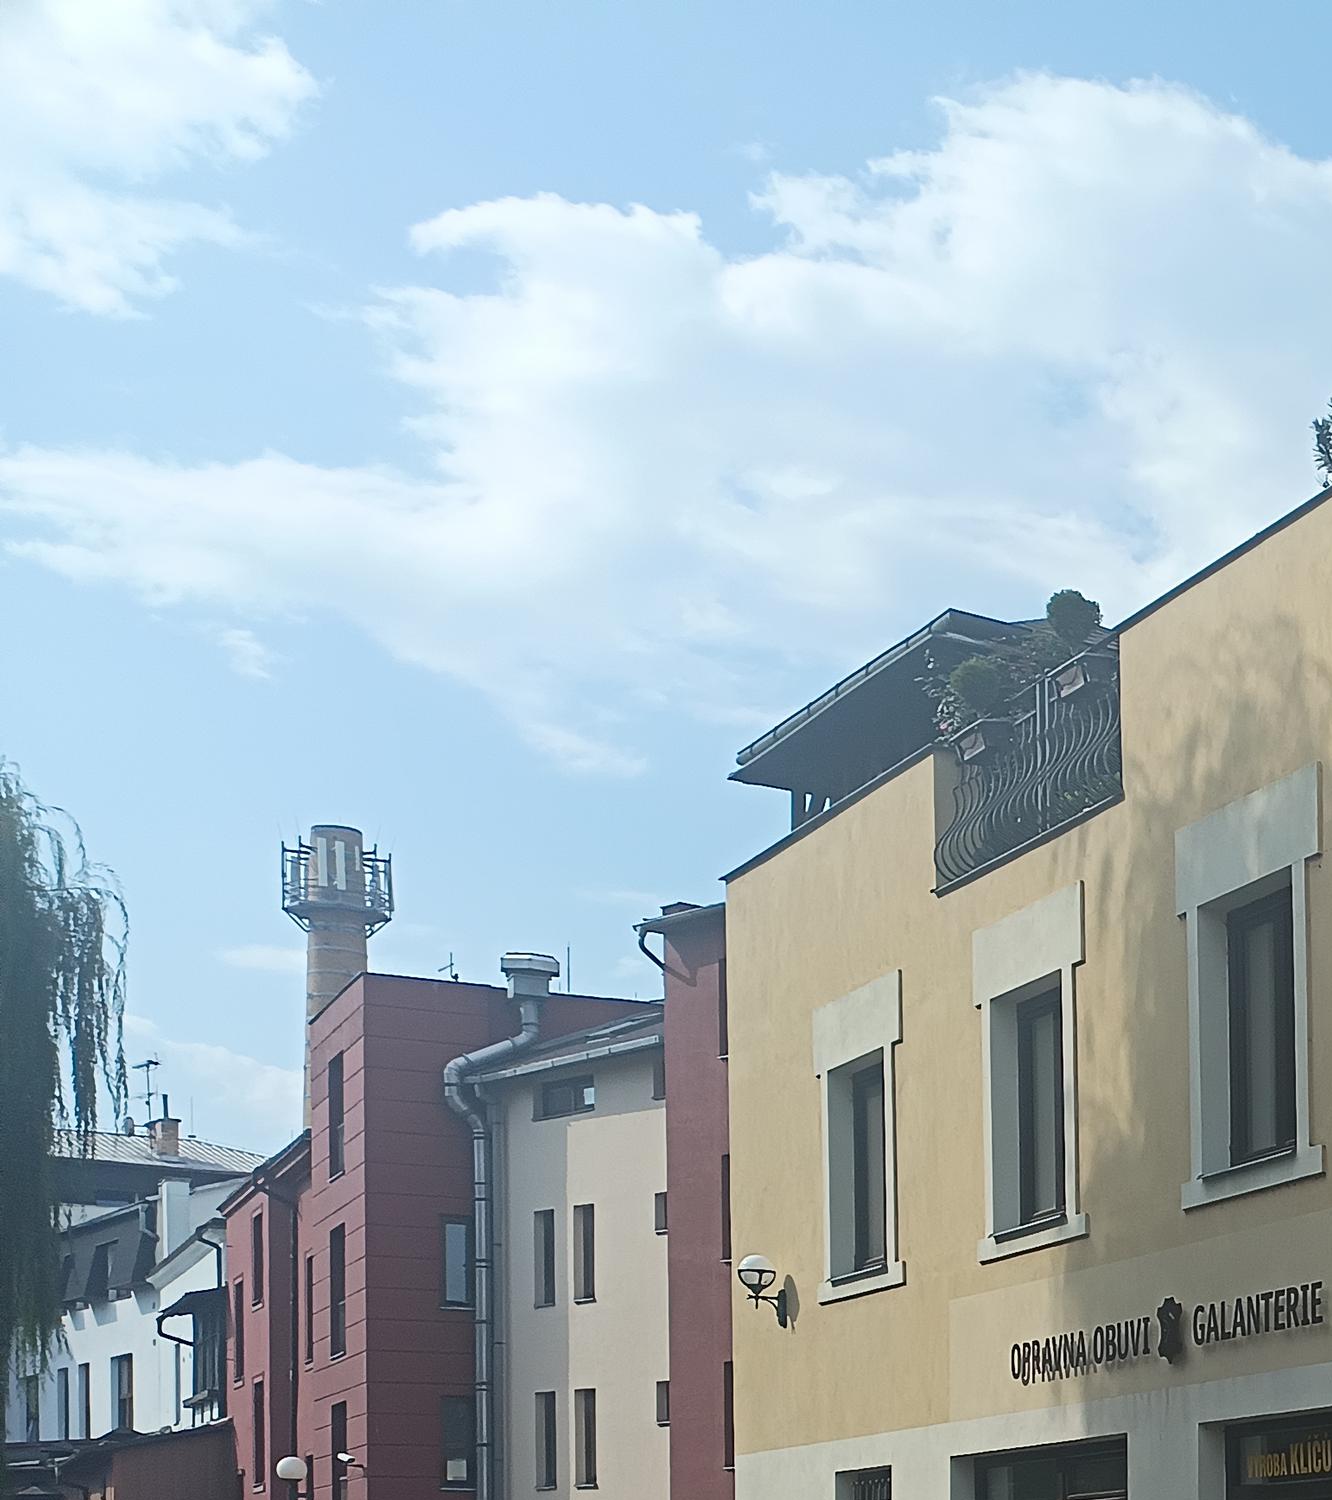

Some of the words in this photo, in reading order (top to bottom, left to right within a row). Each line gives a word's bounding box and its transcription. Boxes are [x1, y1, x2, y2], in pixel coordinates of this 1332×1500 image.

[1193, 1281, 1324, 1346] GALANTERIE
[1011, 1330, 1087, 1382] OPRAVNA
[1093, 1316, 1151, 1364] OBUVI
[1289, 1432, 1332, 1475] KLÍČŮ
